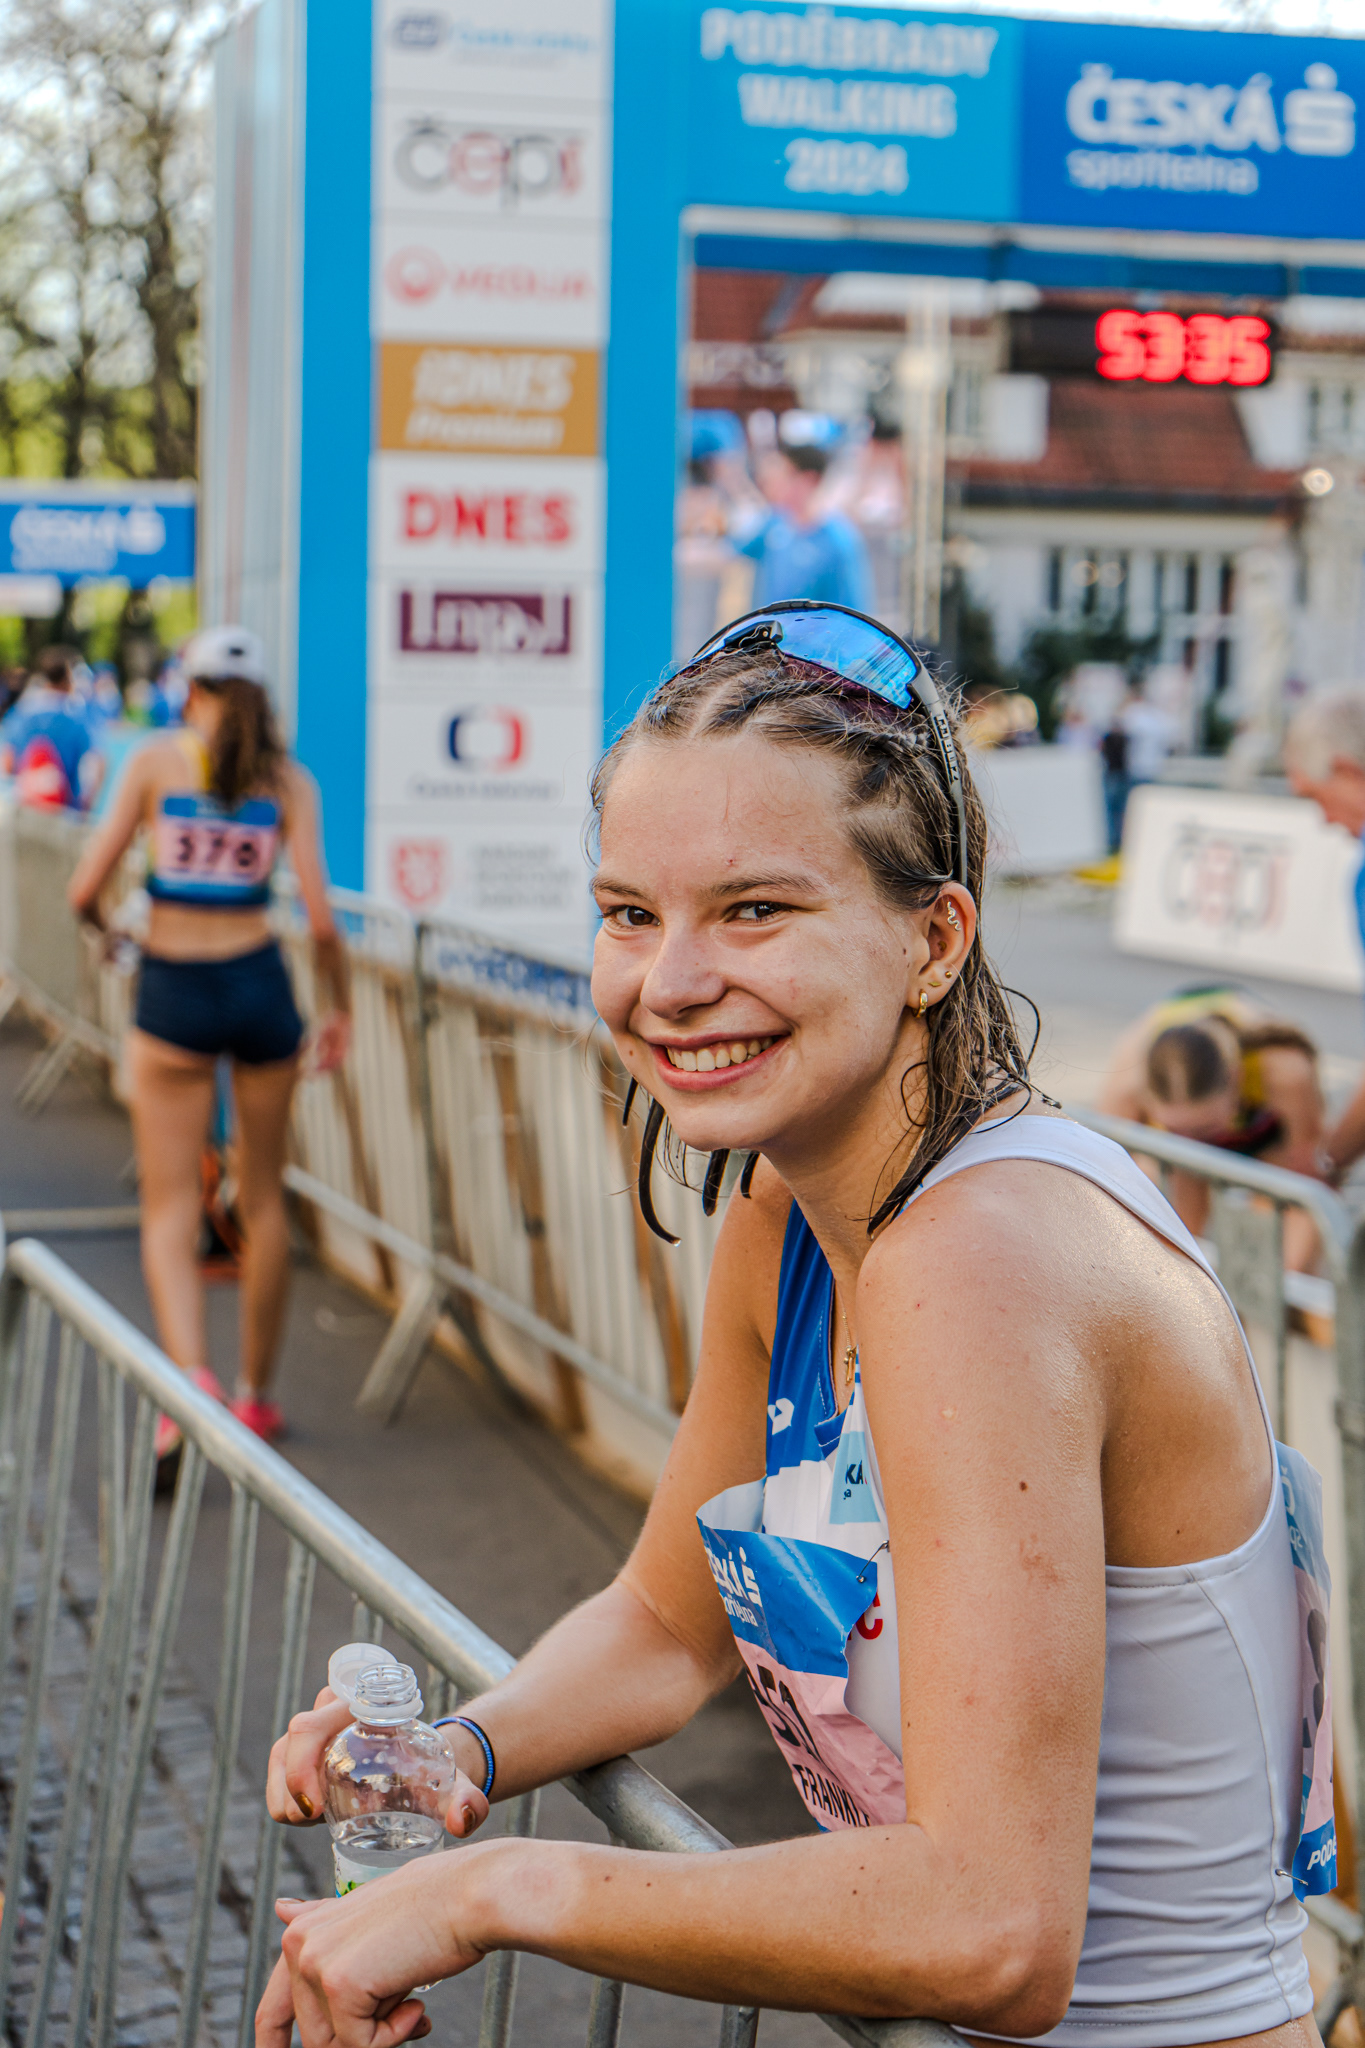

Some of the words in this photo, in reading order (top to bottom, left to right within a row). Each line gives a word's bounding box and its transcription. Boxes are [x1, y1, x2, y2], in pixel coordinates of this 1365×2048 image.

[738, 73, 957, 138] WALKING
[1066, 62, 1281, 153] ČESKÁ
[785, 138, 908, 195] 2024
[403, 490, 574, 545] DNES
